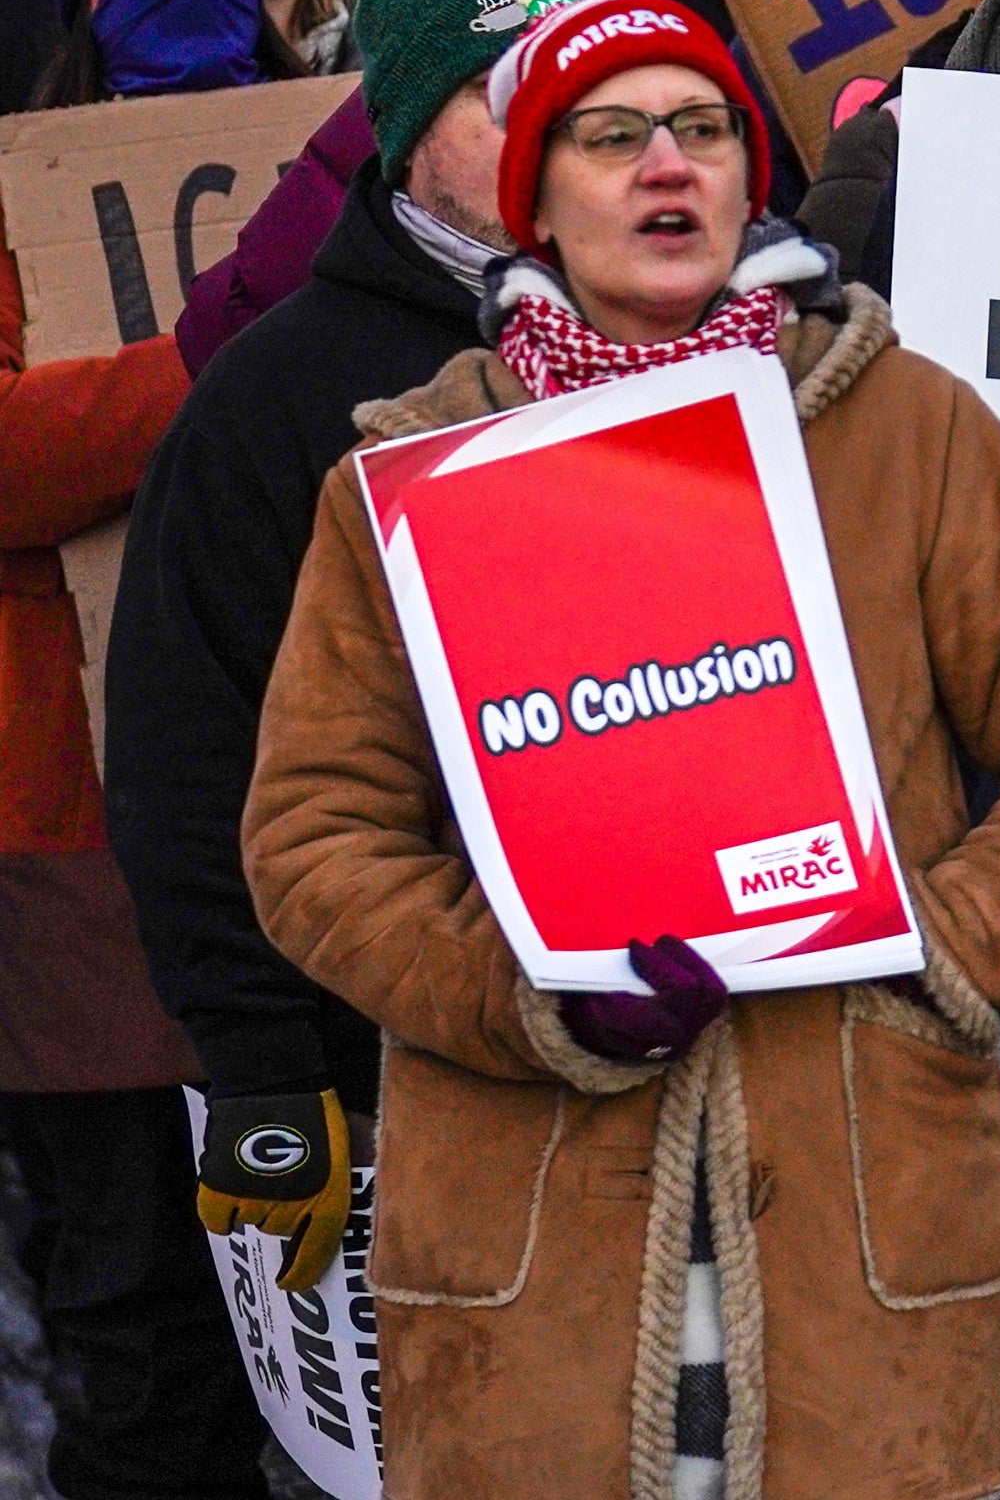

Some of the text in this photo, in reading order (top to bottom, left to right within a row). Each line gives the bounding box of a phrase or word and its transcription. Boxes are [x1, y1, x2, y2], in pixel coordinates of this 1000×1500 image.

[556, 8, 689, 72] MIRAC
[479, 638, 795, 755] NO Collusion
[740, 856, 844, 896] MIRAC
[228, 1223, 273, 1392] IRAC
